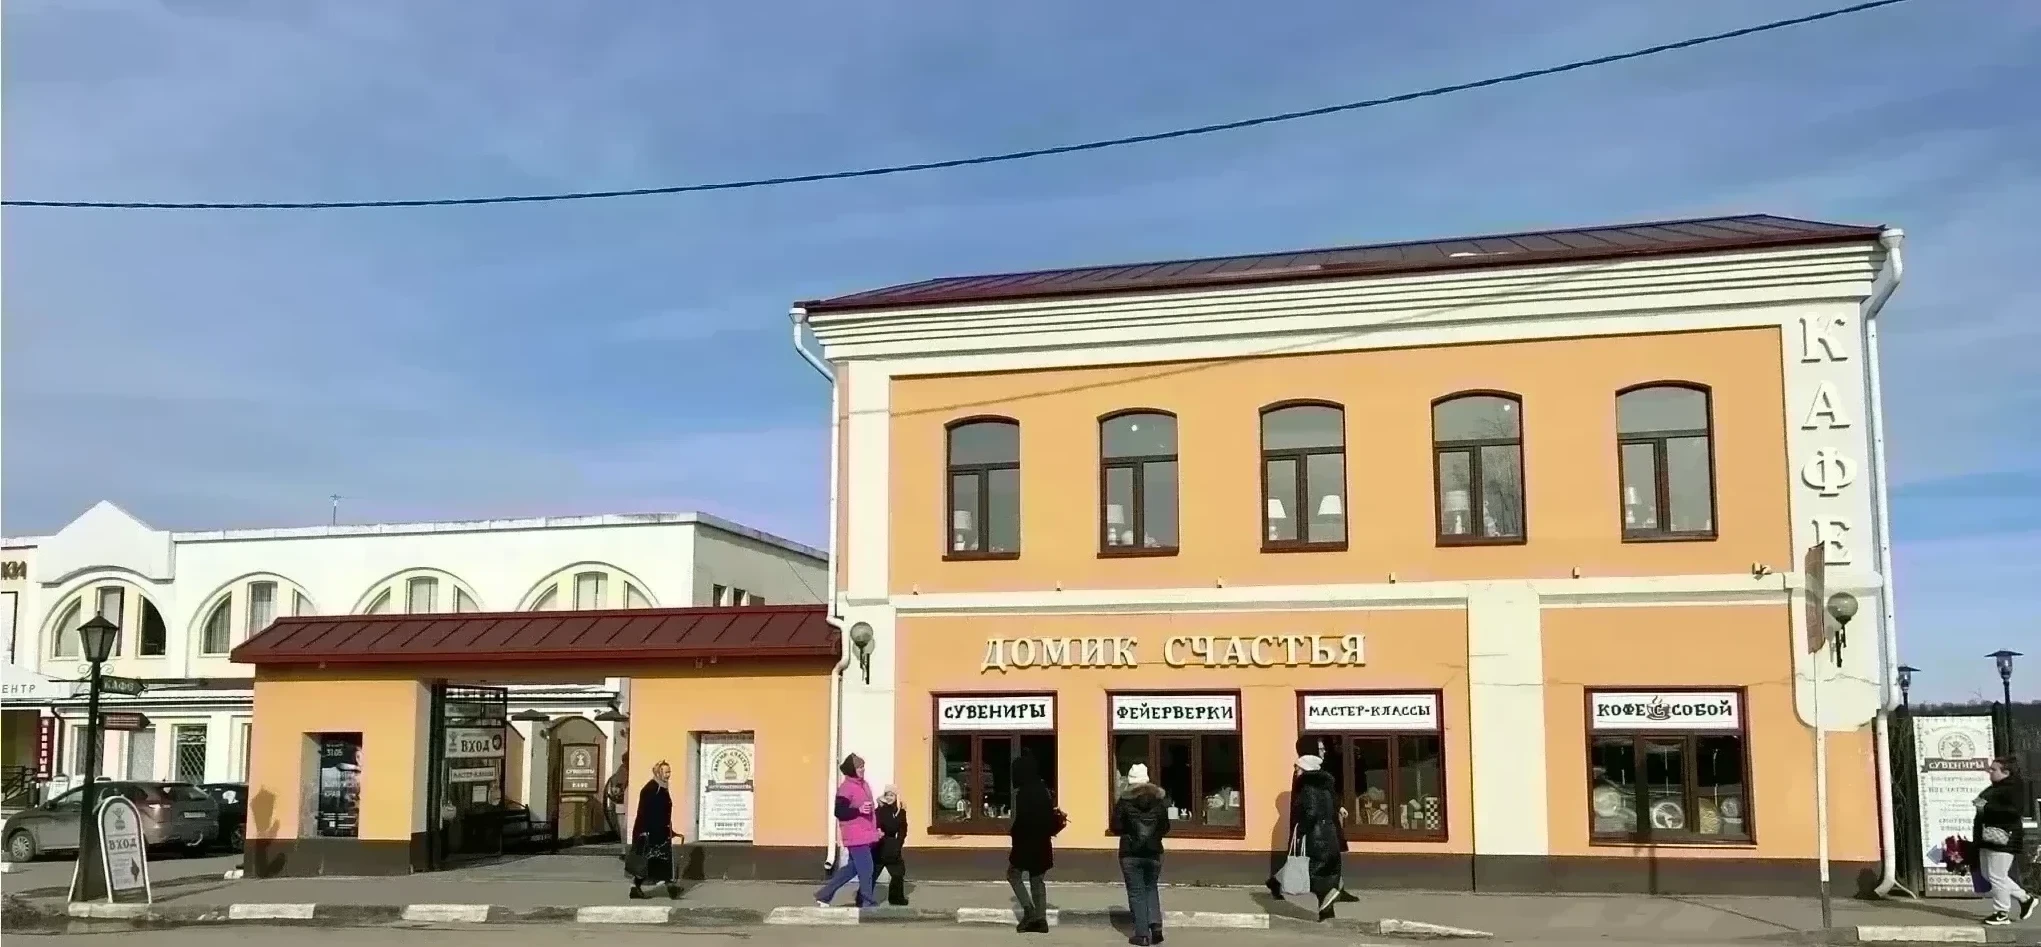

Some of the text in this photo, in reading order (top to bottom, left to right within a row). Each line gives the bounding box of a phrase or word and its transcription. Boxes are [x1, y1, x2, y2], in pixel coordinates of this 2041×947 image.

[1799, 312, 1857, 566] КАФЕ
[981, 634, 1367, 674] ДОМИК СЧАСТЬЯ
[944, 703, 1046, 719] СУВЕНИРЫ
[1116, 702, 1233, 720] ФЕЙЕРВЕРКИ
[1308, 705, 1431, 717] МАСТЕР-КЛАССЫ
[1596, 703, 1646, 717] КОФЕ
[1671, 700, 1732, 717] СОБОЙ
[461, 739, 490, 753] ВХОД
[1928, 760, 1985, 770] СУВЕНИРЫ
[108, 838, 138, 851] ВХОД
